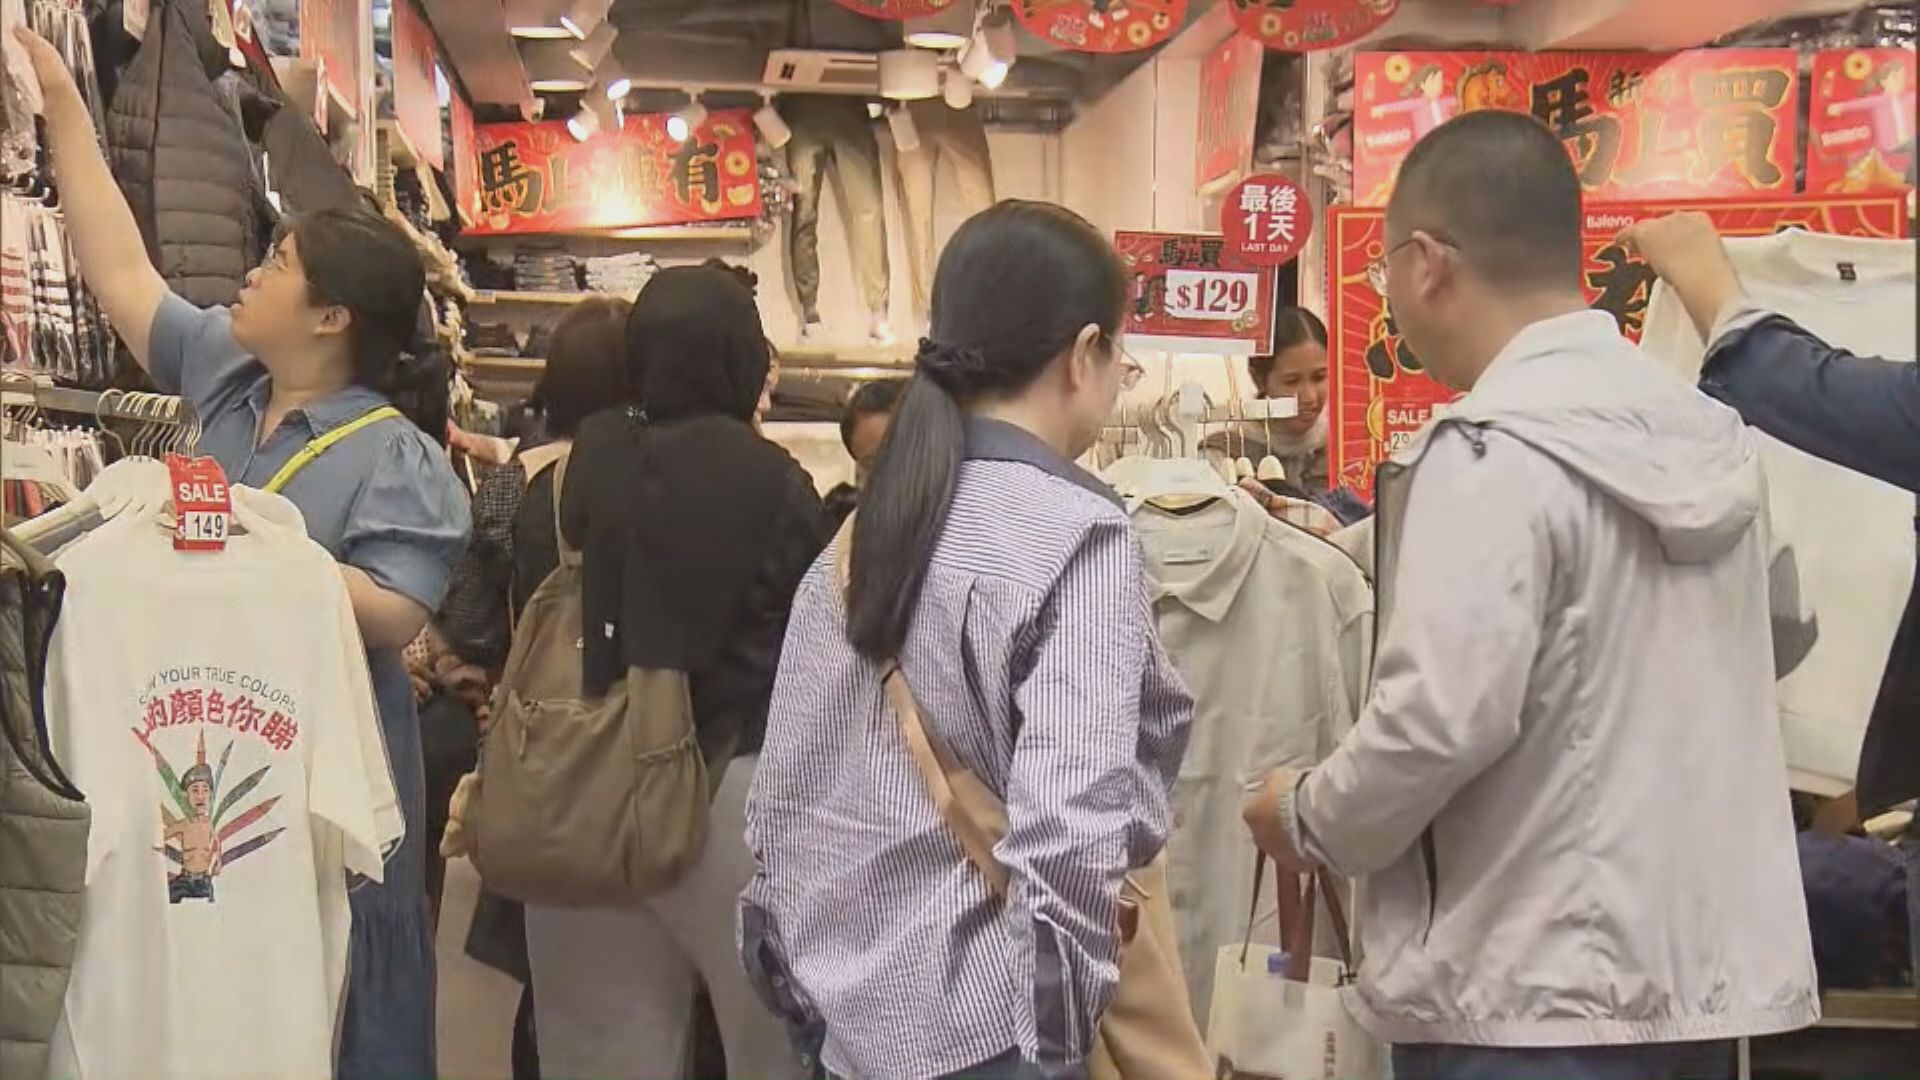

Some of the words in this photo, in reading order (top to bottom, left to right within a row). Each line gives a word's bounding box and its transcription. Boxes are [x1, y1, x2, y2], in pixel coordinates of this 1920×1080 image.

[480, 135, 721, 215] 馬上有
[1239, 185, 1298, 214] 最後
[1243, 213, 1294, 242] 1天
[1586, 213, 1634, 229] Baleno
[1241, 242, 1265, 252] LAST
[1269, 243, 1289, 253] DAY
[1176, 278, 1248, 313] $129
[1387, 408, 1428, 425] SALE
[178, 483, 226, 502] SALE
[159, 667, 201, 684] YOUR
[205, 667, 236, 684] TRUE
[240, 675, 297, 714] COLORS
